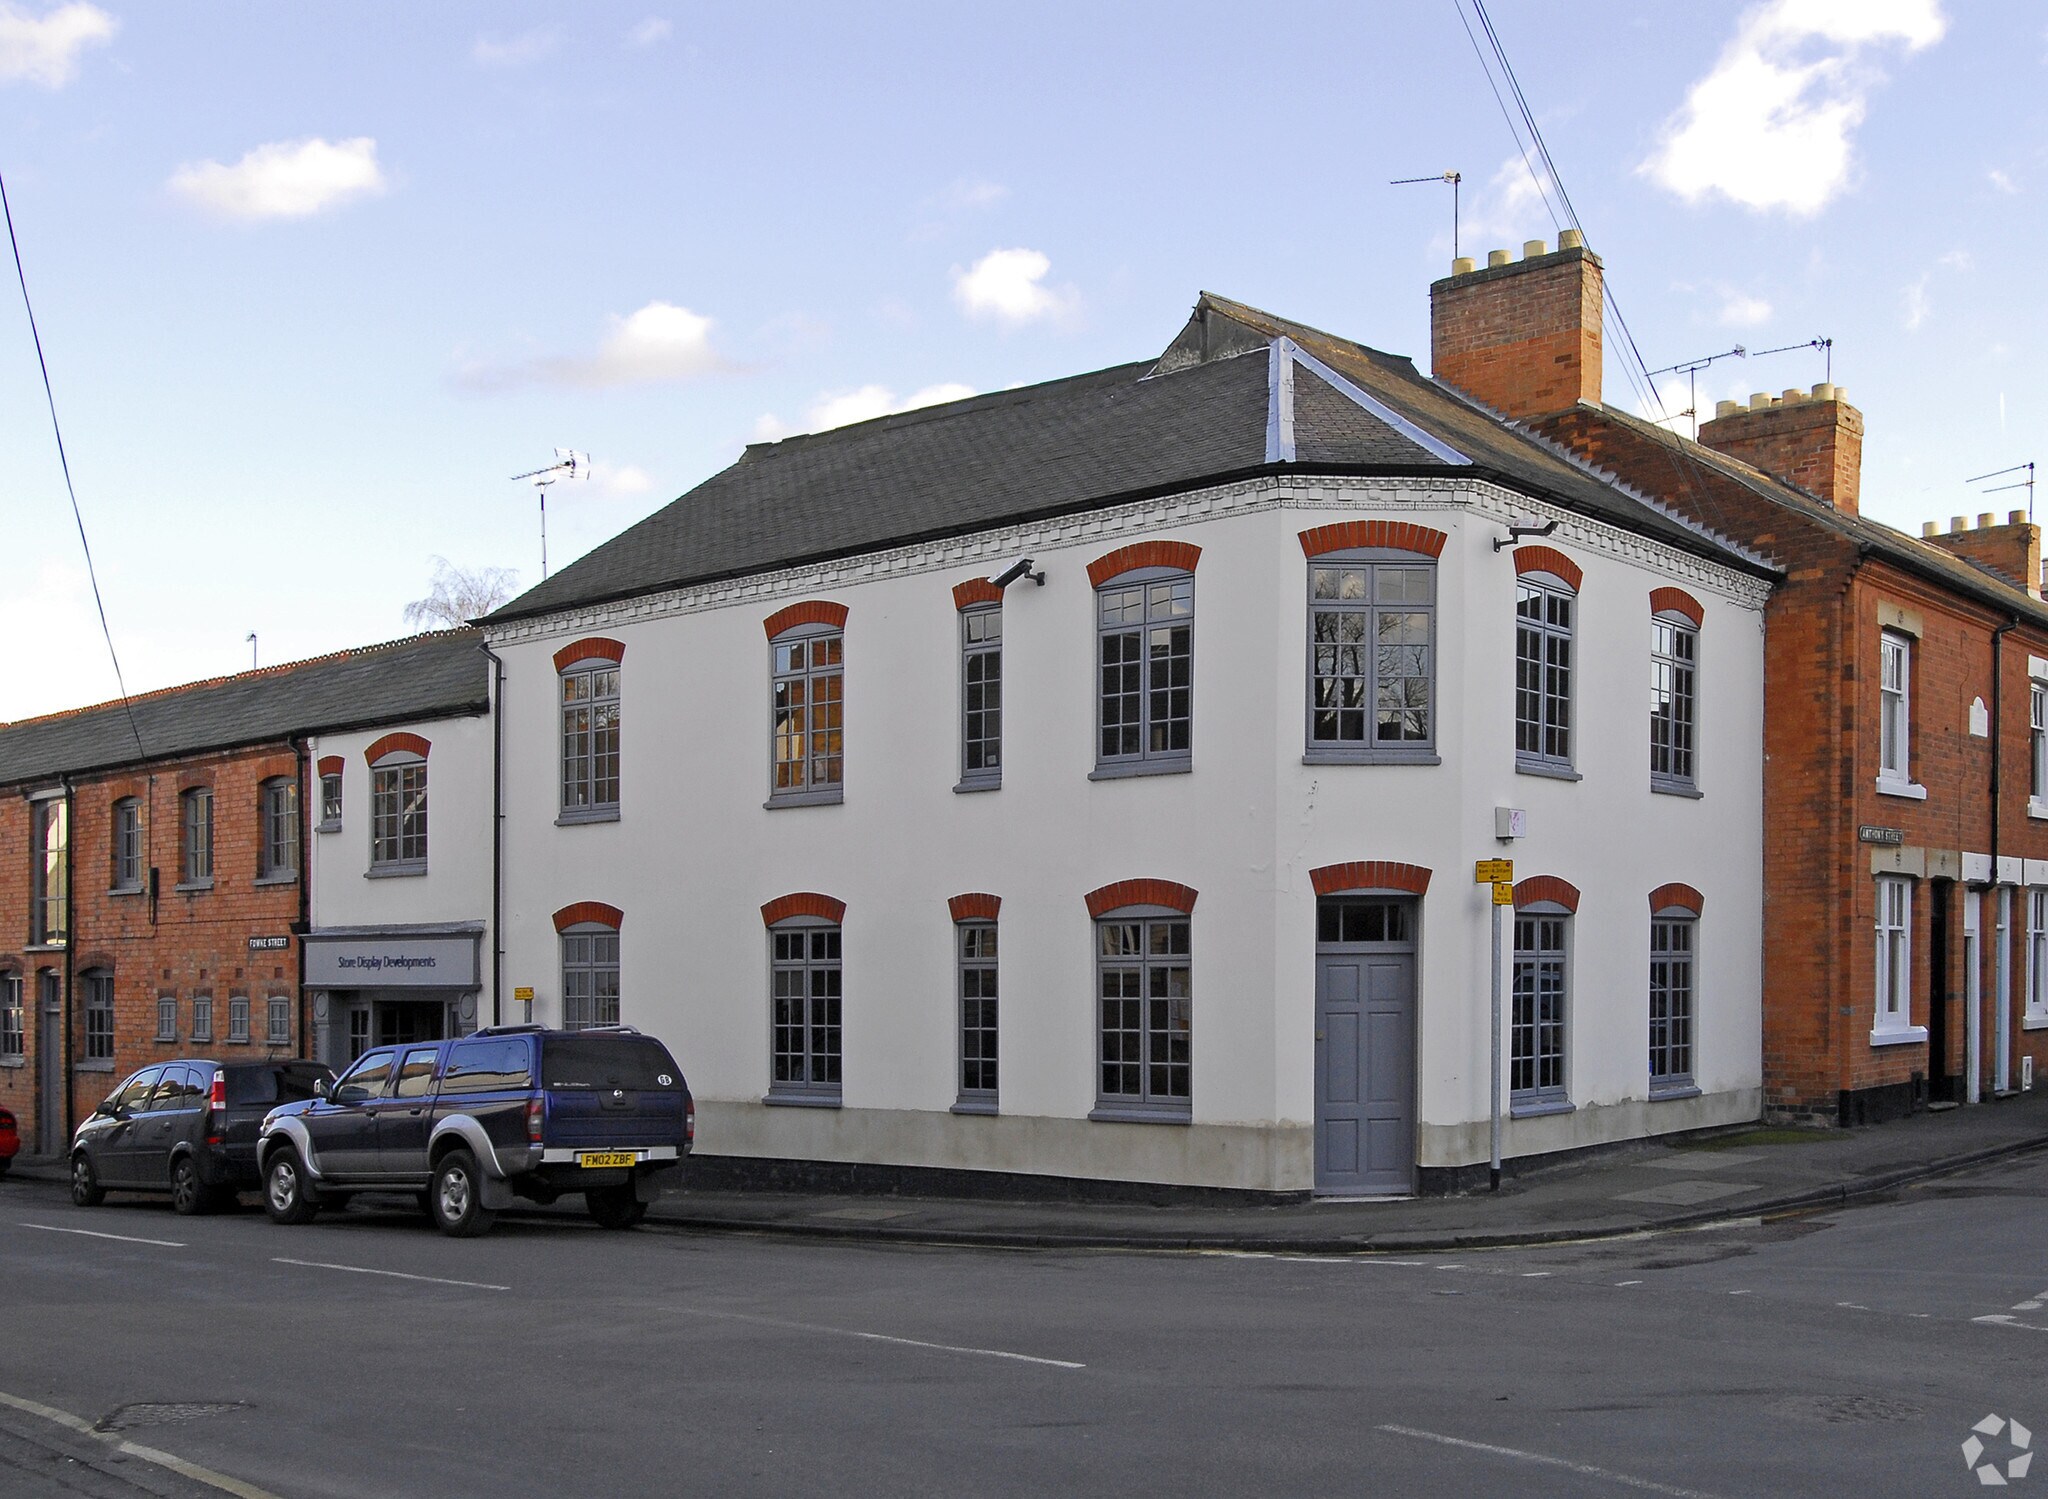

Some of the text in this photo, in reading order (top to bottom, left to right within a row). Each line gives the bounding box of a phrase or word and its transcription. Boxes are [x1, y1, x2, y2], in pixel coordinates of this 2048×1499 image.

[1862, 828, 1903, 841] ANTHONY STREET
[250, 937, 287, 948] FOWKE STREET
[338, 955, 436, 971] Store Display Developments
[585, 1153, 632, 1166] FM02 ZBF
